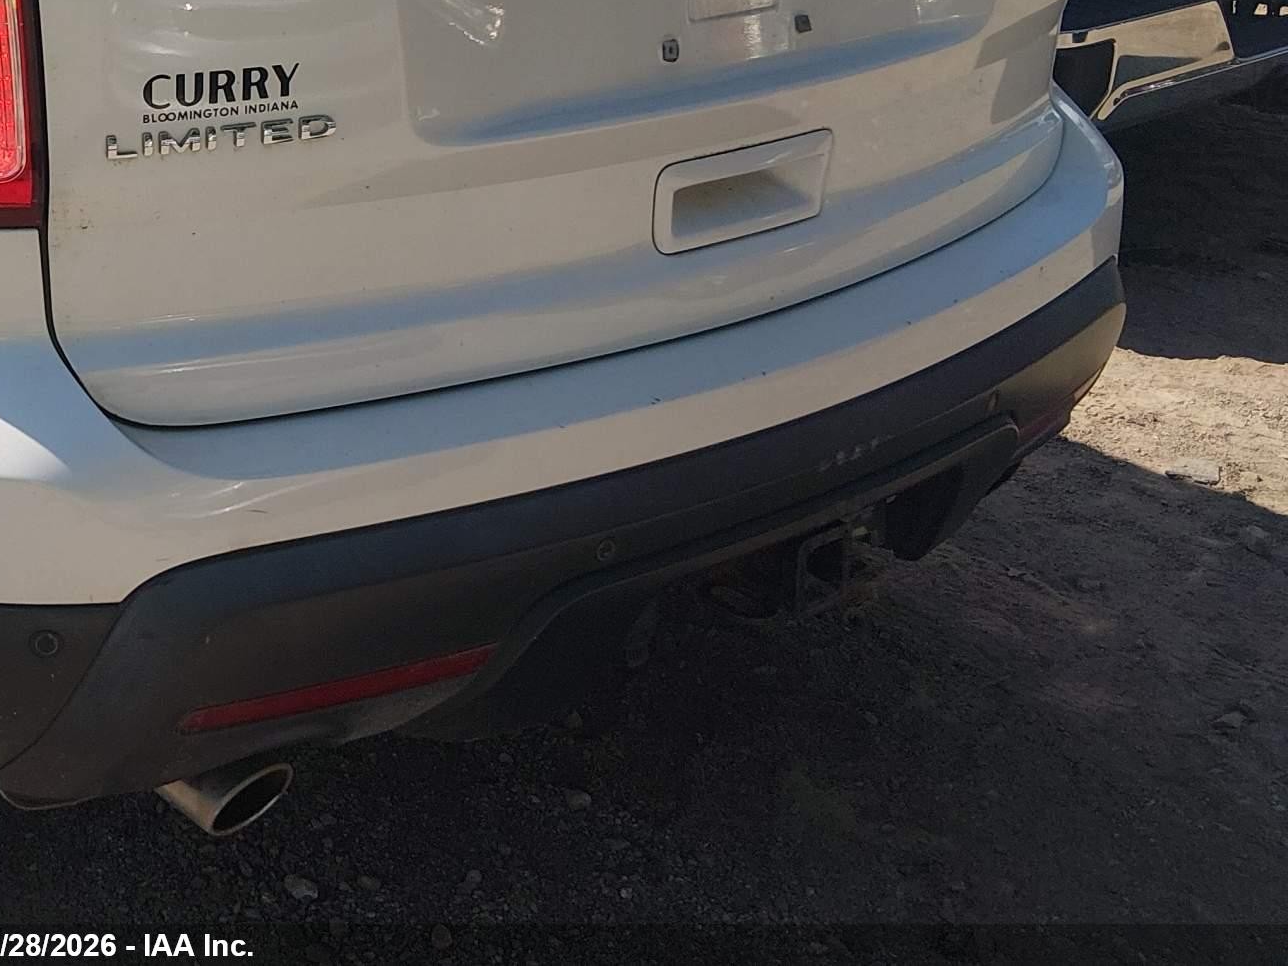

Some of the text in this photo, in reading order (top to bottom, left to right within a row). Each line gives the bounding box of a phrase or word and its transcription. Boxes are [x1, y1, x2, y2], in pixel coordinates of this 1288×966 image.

[142, 62, 301, 110] CURRY
[142, 100, 299, 124] BLOOMINGTON INDIANA
[106, 114, 338, 161] LIMITED
